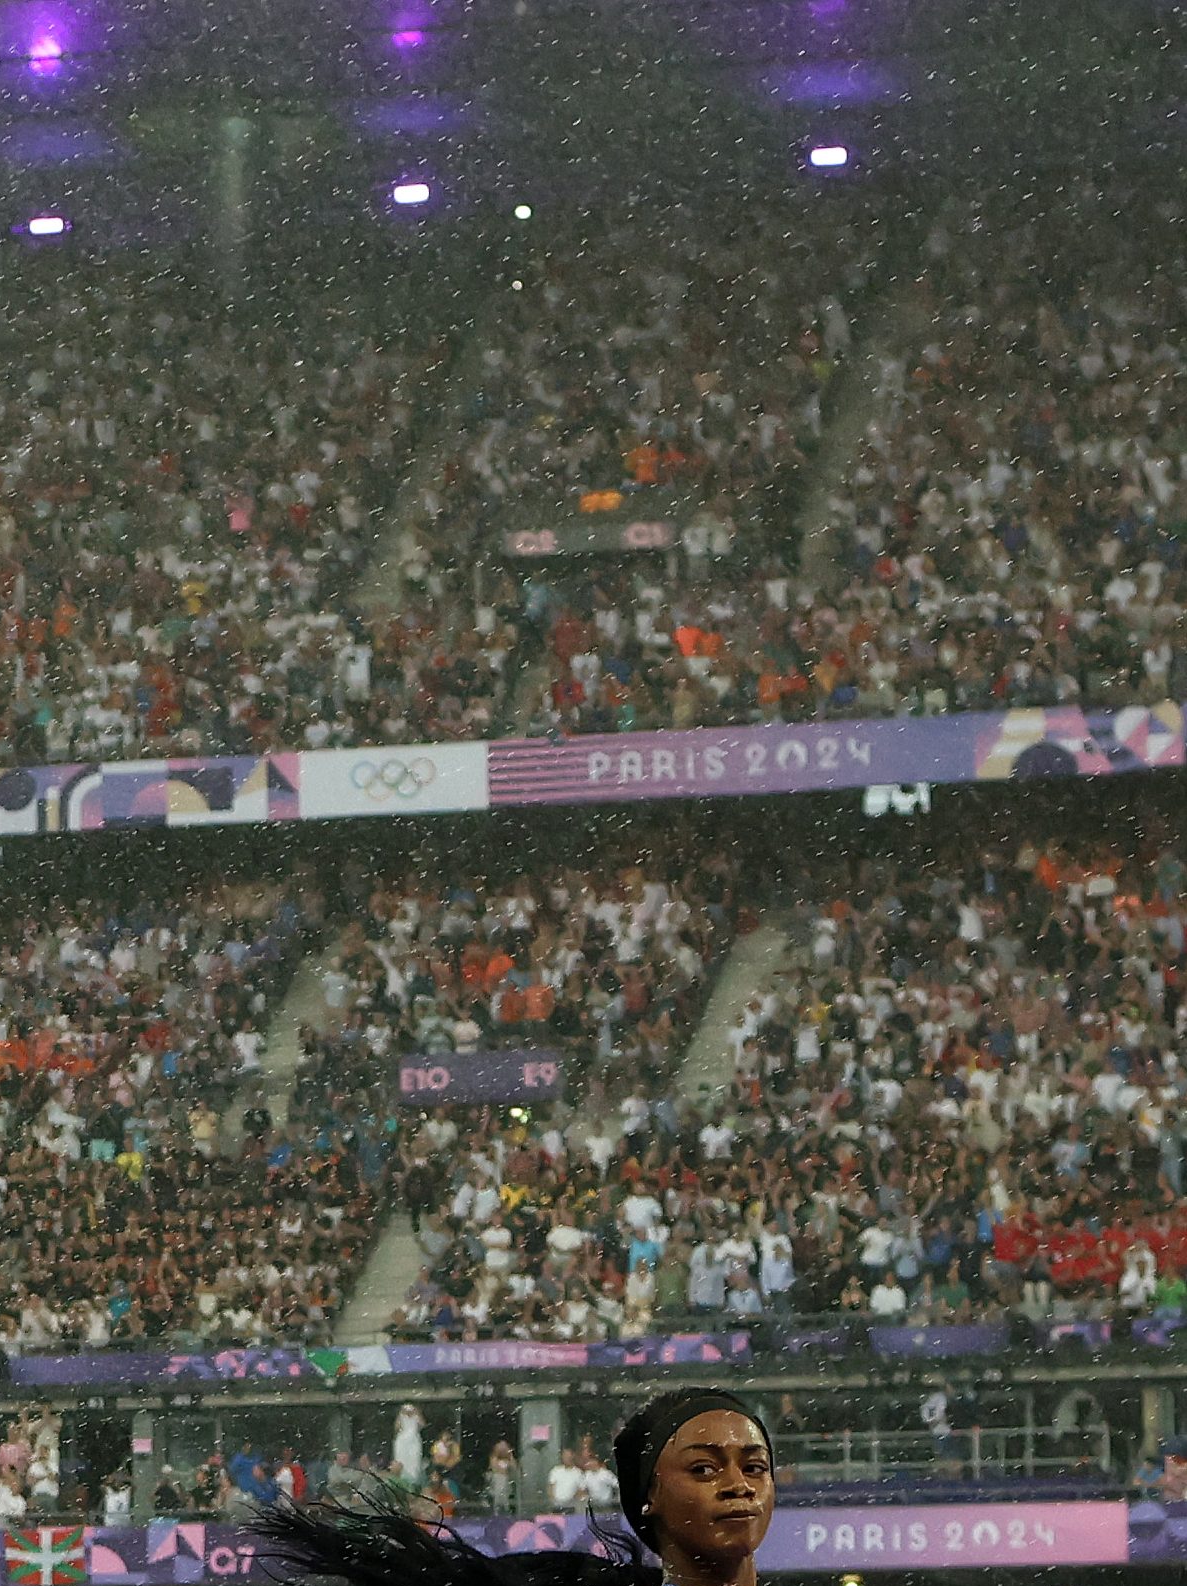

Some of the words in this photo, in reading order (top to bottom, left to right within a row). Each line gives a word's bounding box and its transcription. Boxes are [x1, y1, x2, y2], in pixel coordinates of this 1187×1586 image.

[588, 745, 726, 784] PARIS
[744, 737, 872, 776] 2024
[806, 1521, 928, 1552] PARIS
[944, 1519, 1056, 1550] 2024
